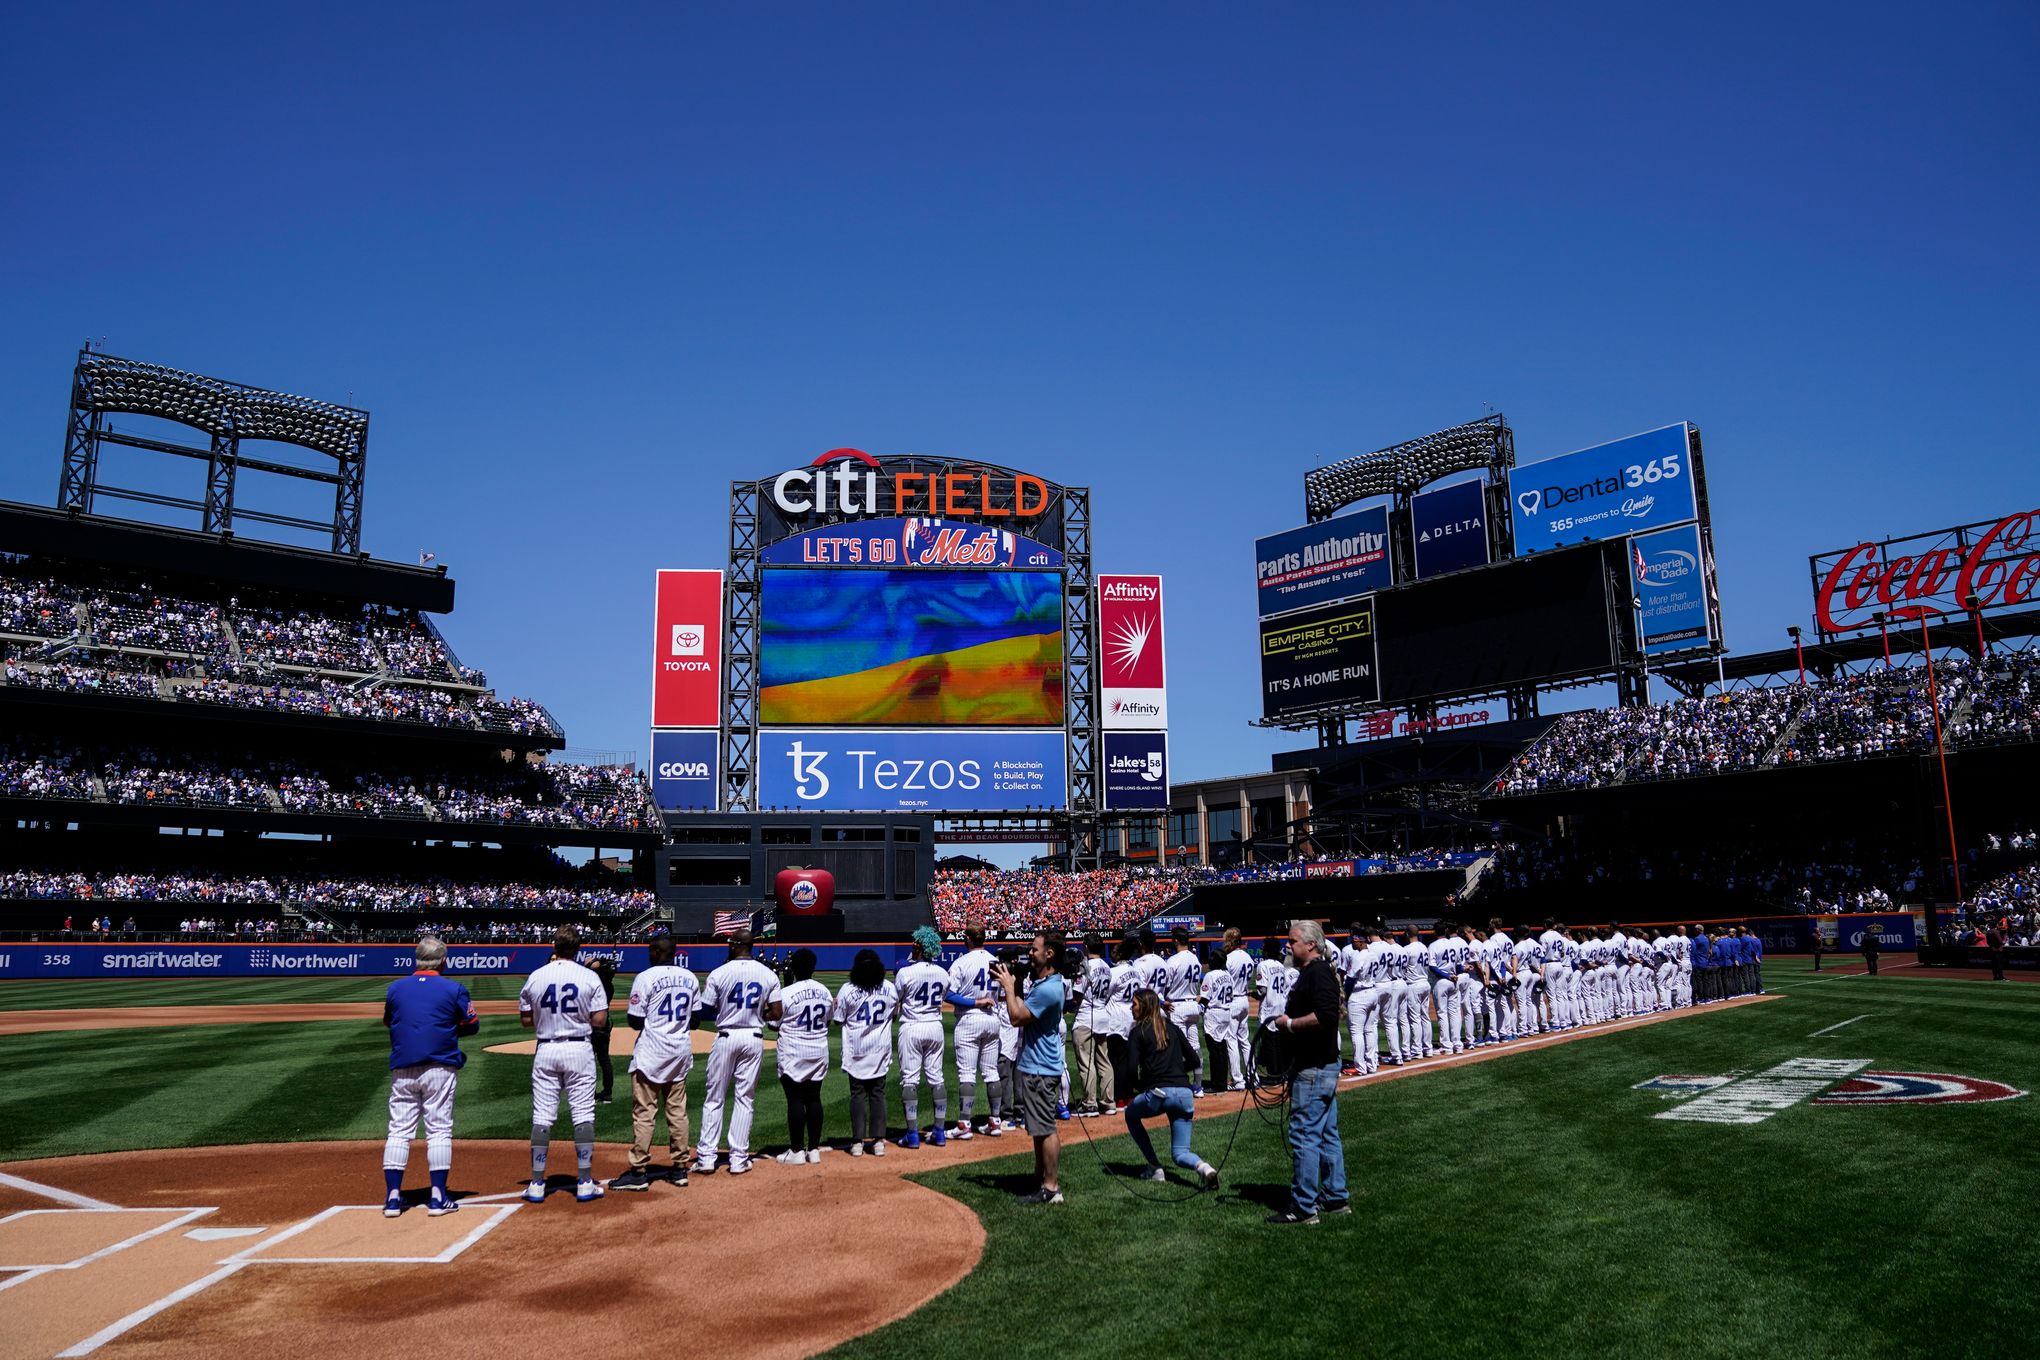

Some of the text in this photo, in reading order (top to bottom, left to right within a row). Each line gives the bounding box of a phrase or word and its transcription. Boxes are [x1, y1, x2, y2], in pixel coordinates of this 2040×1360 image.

[774, 459, 1049, 516] citi FIELD
[1544, 454, 1681, 510] Dental365
[1550, 517, 1574, 533] 365
[1575, 510, 1609, 526] reasons
[1620, 495, 1655, 517] Smile
[1434, 517, 1482, 538] DELTA
[804, 528, 997, 565] LET'S GO Mets
[1258, 532, 1383, 579] Parts Authority
[1262, 552, 1380, 586] Auto Parts Super Stores
[1645, 557, 1684, 574] mperial
[1661, 567, 1689, 580] Dade
[1297, 577, 1331, 590] Answer
[1332, 574, 1341, 582] Is
[1104, 583, 1158, 600] Affinity
[1648, 592, 1687, 606] More than
[1656, 598, 1701, 615] distribution!
[1268, 620, 1364, 647] EMPIRE CITY
[1648, 630, 1698, 644] ImperialDade.com
[1298, 637, 1334, 650] CASINO
[1314, 648, 1338, 656] RESORTS
[664, 662, 712, 671] TOYOTA
[1269, 664, 1369, 693] IT'S A HOME RUN
[1121, 703, 1160, 716] Affinity
[1399, 710, 1490, 734] new balance
[658, 762, 709, 778] GOYA
[993, 761, 1043, 770] A Blockchain
[1109, 755, 1148, 768] Jake's
[1149, 759, 1161, 768] 58
[846, 751, 981, 790] Tezos
[993, 771, 1044, 783] to Build, Play
[993, 782, 1043, 791] & Collect on.
[1014, 930, 1036, 939] Coors
[1503, 942, 1513, 955] 42
[1532, 947, 1541, 959] 42
[1552, 940, 1563, 952] 42
[43, 955, 71, 965] 358
[103, 951, 222, 968] smartwater
[271, 954, 358, 968] Northwell
[394, 958, 412, 968] 370
[446, 953, 509, 968] verizon
[1379, 952, 1394, 969] 42
[1395, 954, 1408, 970] 42
[1417, 952, 1429, 967] 42
[1442, 949, 1456, 962] 42
[1185, 964, 1201, 983] 42
[1239, 963, 1253, 981] 42
[1368, 961, 1379, 977] 42
[1150, 968, 1167, 988] 42
[728, 982, 763, 1009] 42
[915, 982, 944, 1006] 42
[1093, 979, 1110, 999] 42
[1218, 985, 1233, 1004] 42
[541, 983, 579, 1014] 42
[658, 992, 690, 1022] 42
[798, 1004, 826, 1032] 42
[857, 1000, 886, 1026] 42
